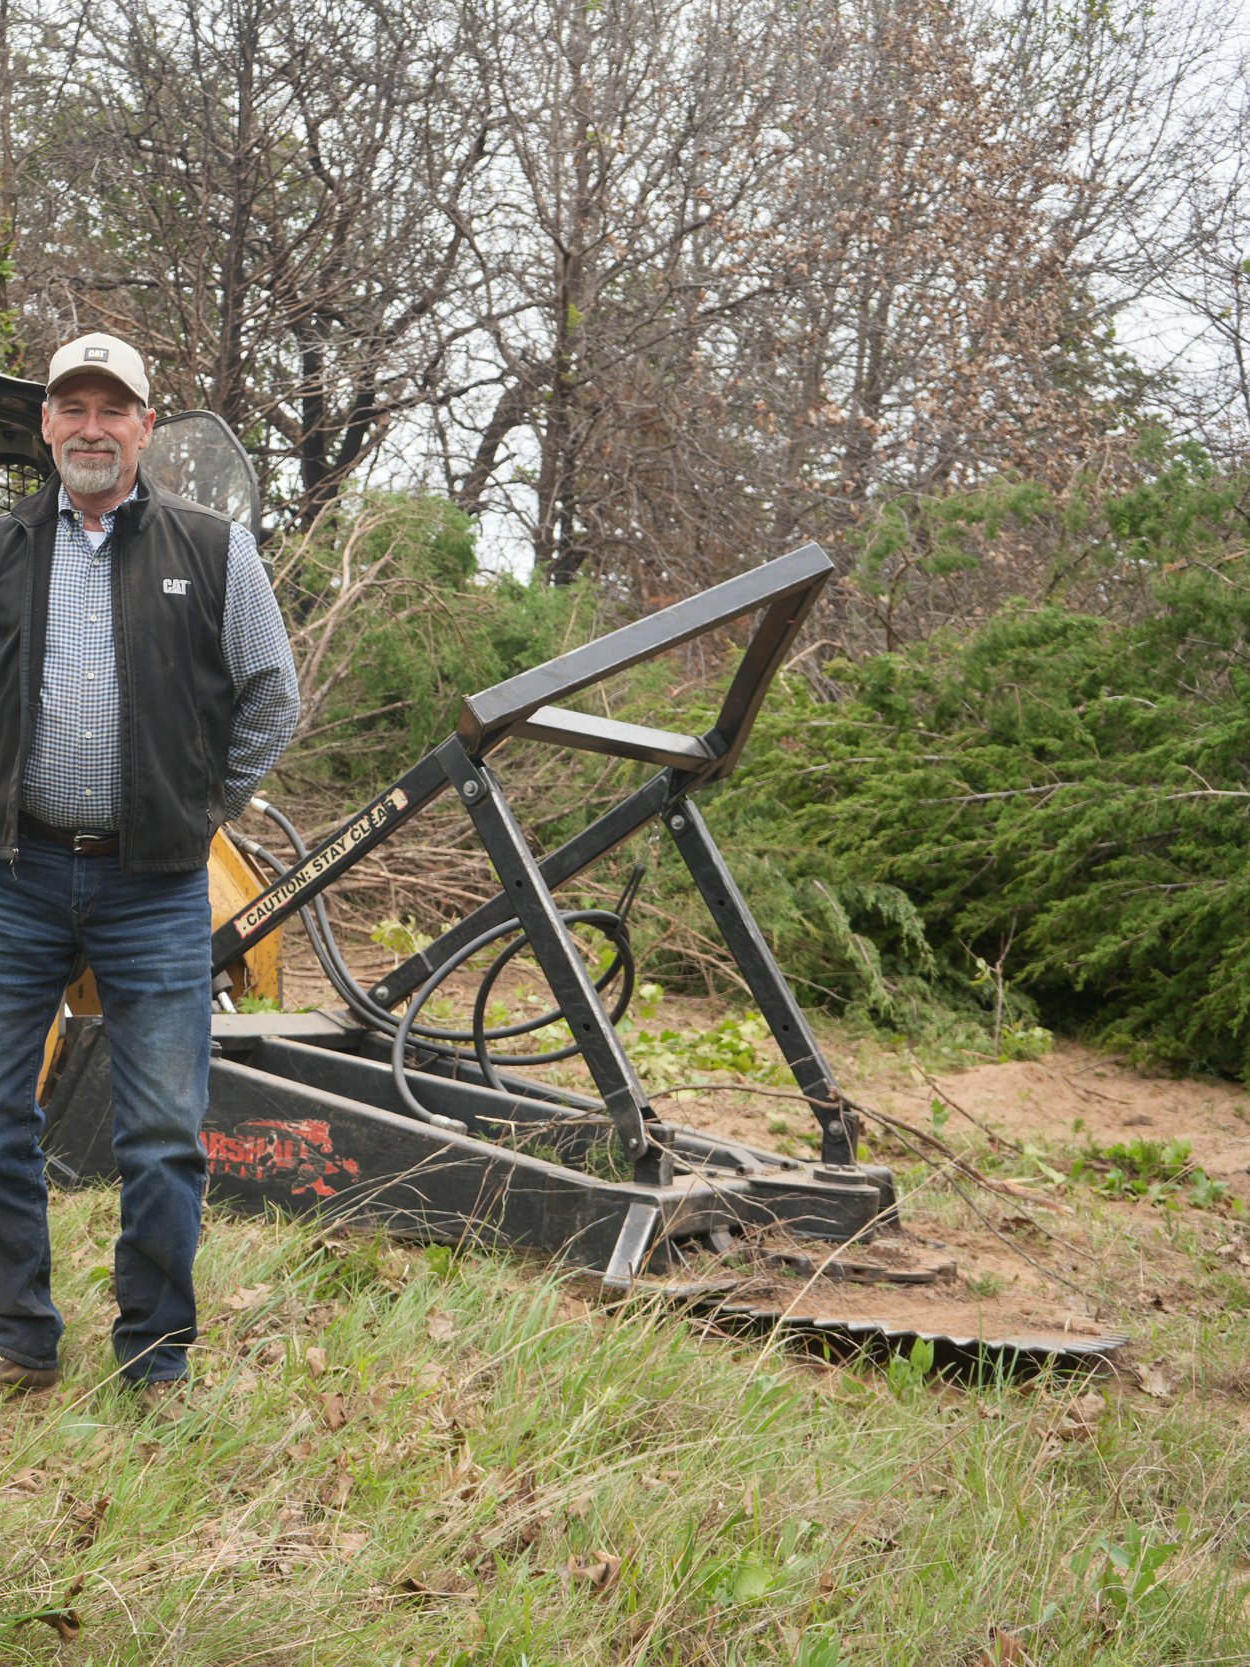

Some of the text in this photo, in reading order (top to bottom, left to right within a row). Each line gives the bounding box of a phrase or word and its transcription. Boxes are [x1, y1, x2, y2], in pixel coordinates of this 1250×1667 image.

[88, 349, 108, 357] CAT
[162, 578, 189, 594] CAT
[246, 871, 311, 926] CAUTION:
[312, 837, 347, 872] STAY
